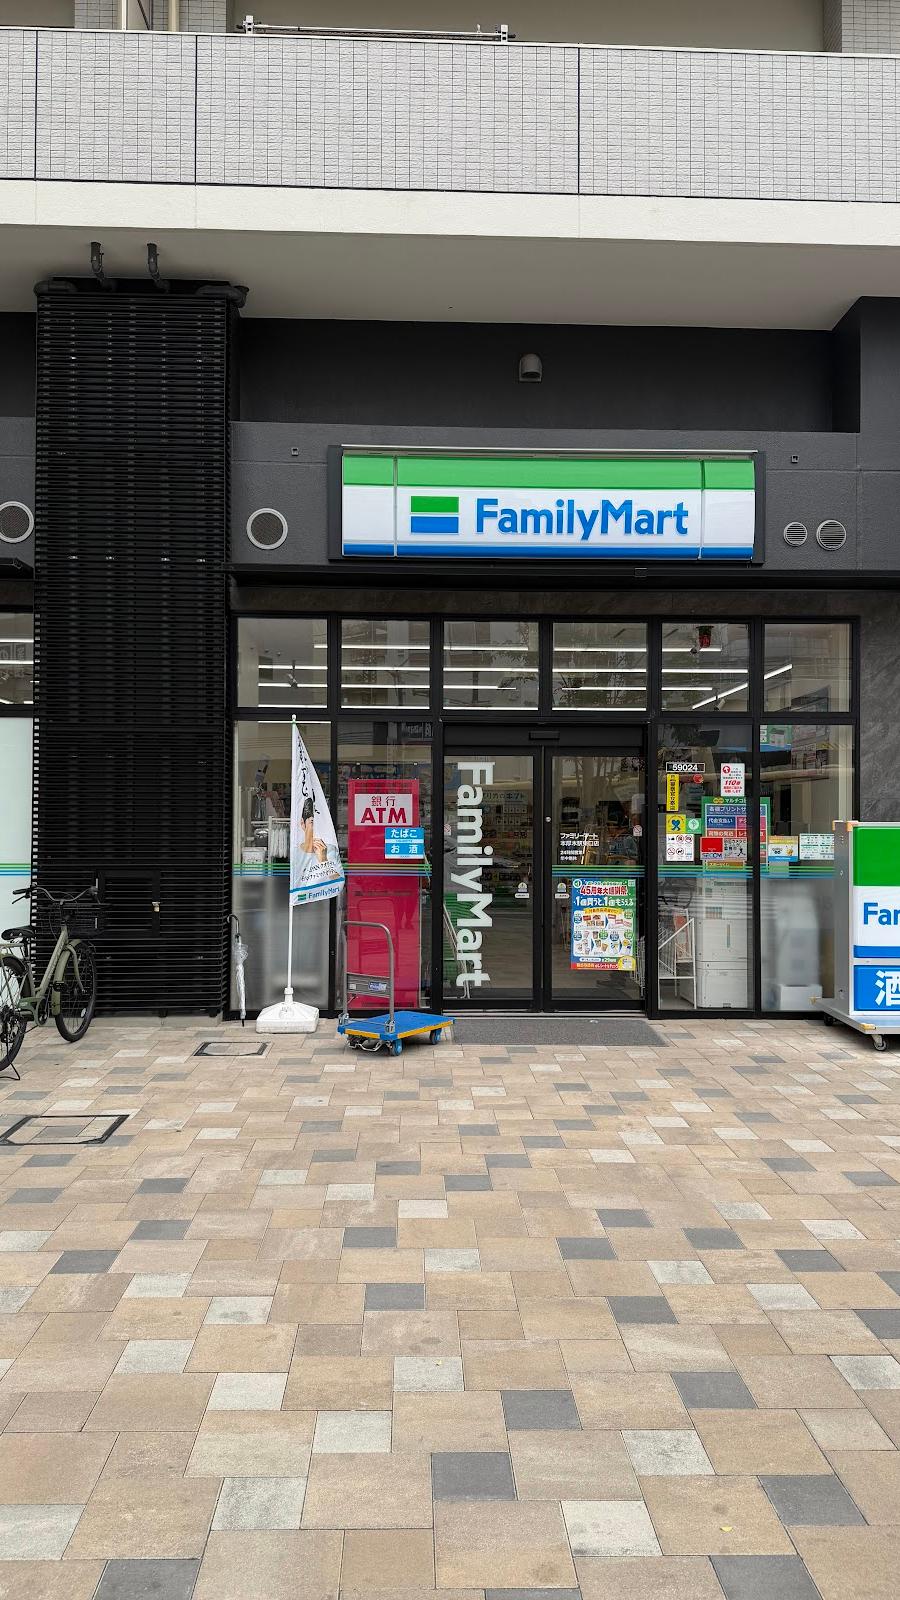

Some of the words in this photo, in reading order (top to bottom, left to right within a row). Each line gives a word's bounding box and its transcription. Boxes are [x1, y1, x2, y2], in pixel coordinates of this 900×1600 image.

[476, 498, 688, 540] FamilyMart
[371, 796, 396, 806] 銀行
[361, 808, 407, 823] ATM
[391, 829, 417, 838] たばこ
[391, 844, 418, 854] お酒
[451, 762, 495, 987] FamilyMart
[308, 886, 340, 899] FamilyMart
[875, 970, 900, 1006] 酒
